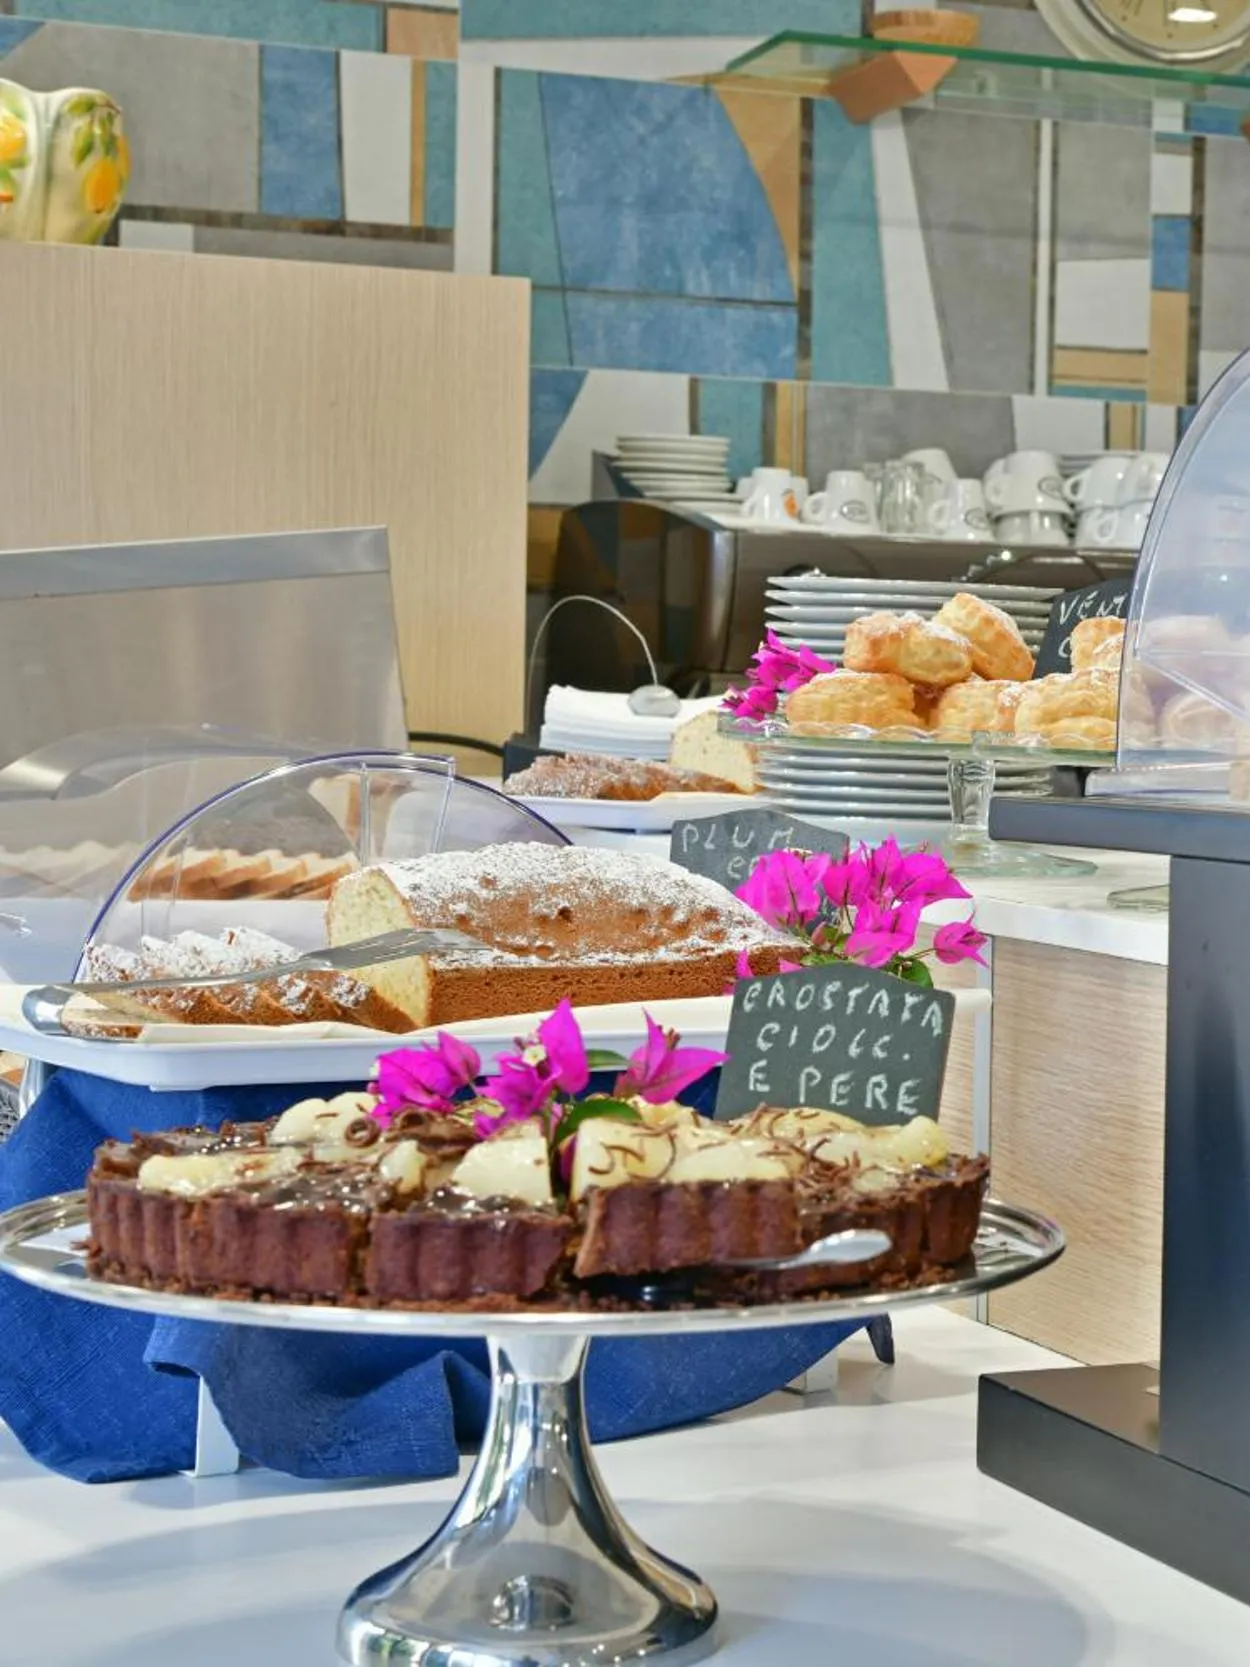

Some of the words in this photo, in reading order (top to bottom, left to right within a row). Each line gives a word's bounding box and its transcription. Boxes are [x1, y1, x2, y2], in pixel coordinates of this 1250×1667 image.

[682, 824, 794, 852] PLUM
[743, 979, 944, 1037] CROSTATA
[749, 1059, 771, 1093] E
[799, 1065, 923, 1116] PERE
